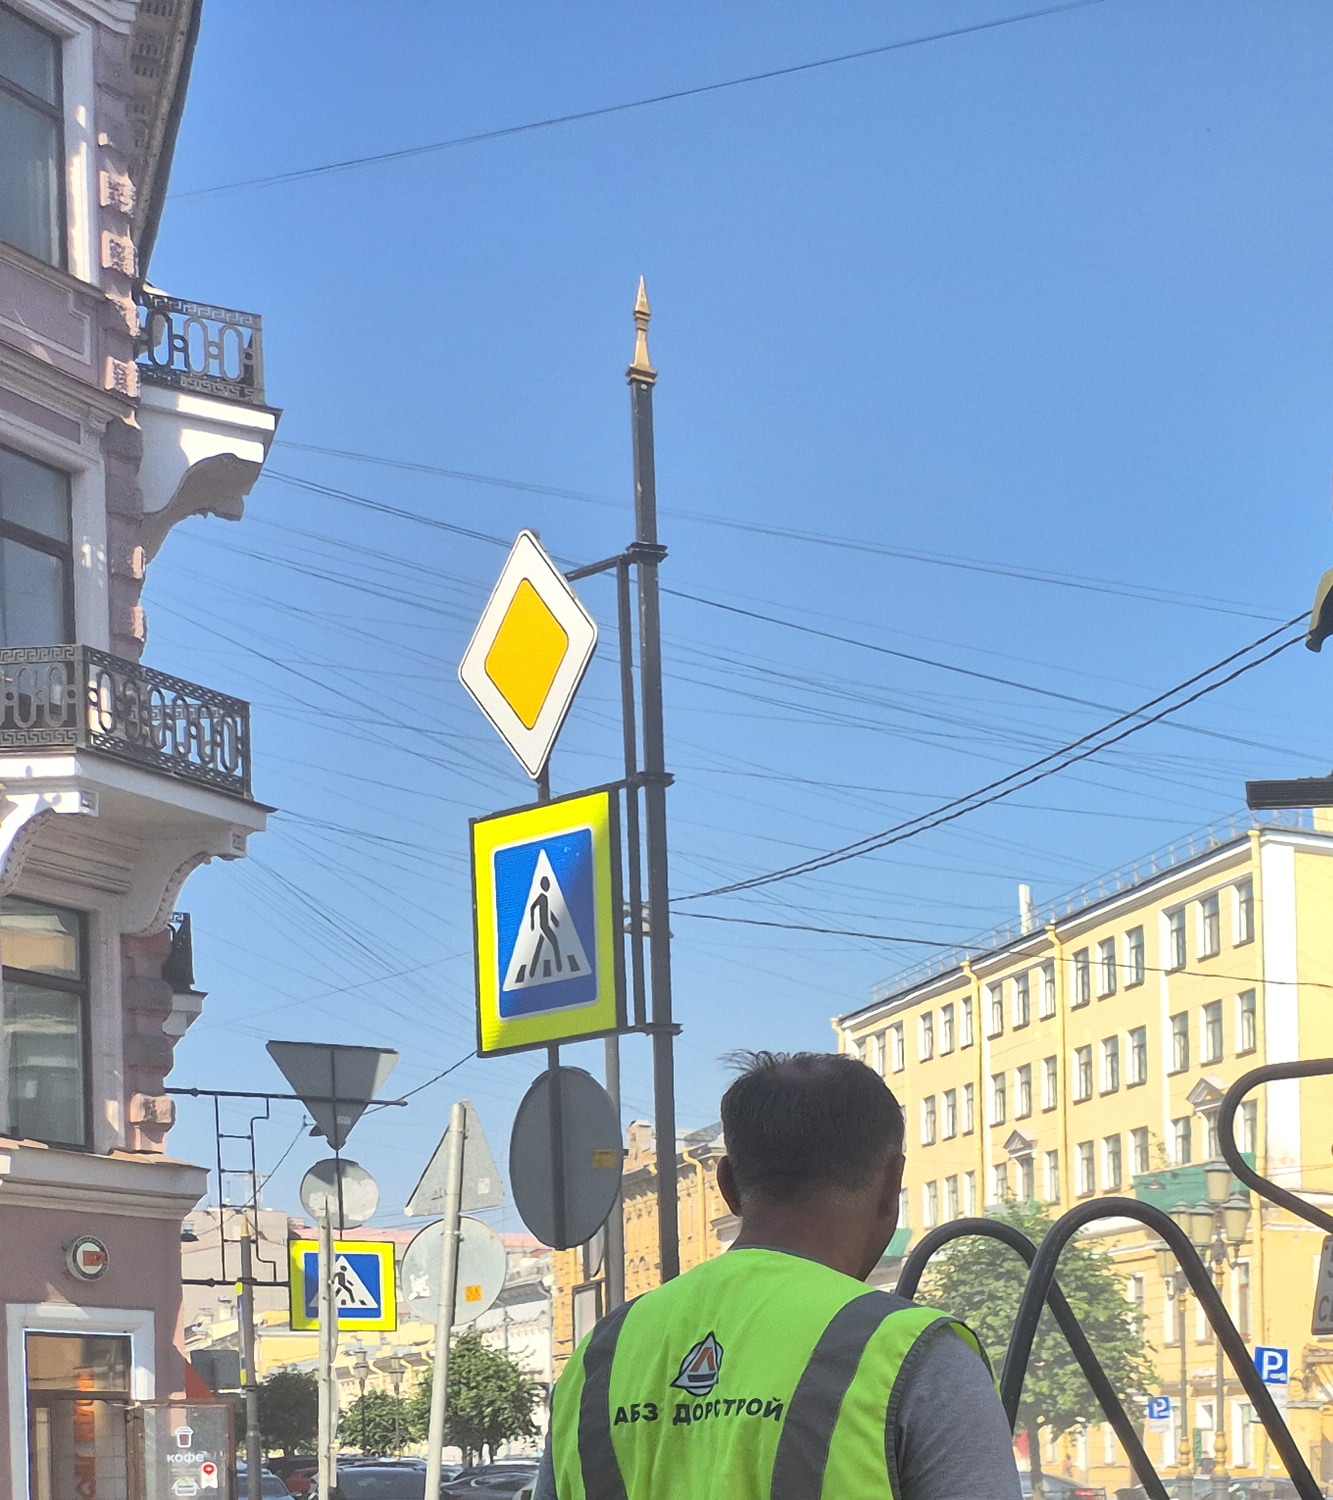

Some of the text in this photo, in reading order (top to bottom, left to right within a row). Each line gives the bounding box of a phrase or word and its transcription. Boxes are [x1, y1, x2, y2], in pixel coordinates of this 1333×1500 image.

[1262, 1350, 1283, 1380] P
[613, 1396, 784, 1426] АБЗ ДОРСТРОЙ
[166, 1452, 205, 1465] кофе
